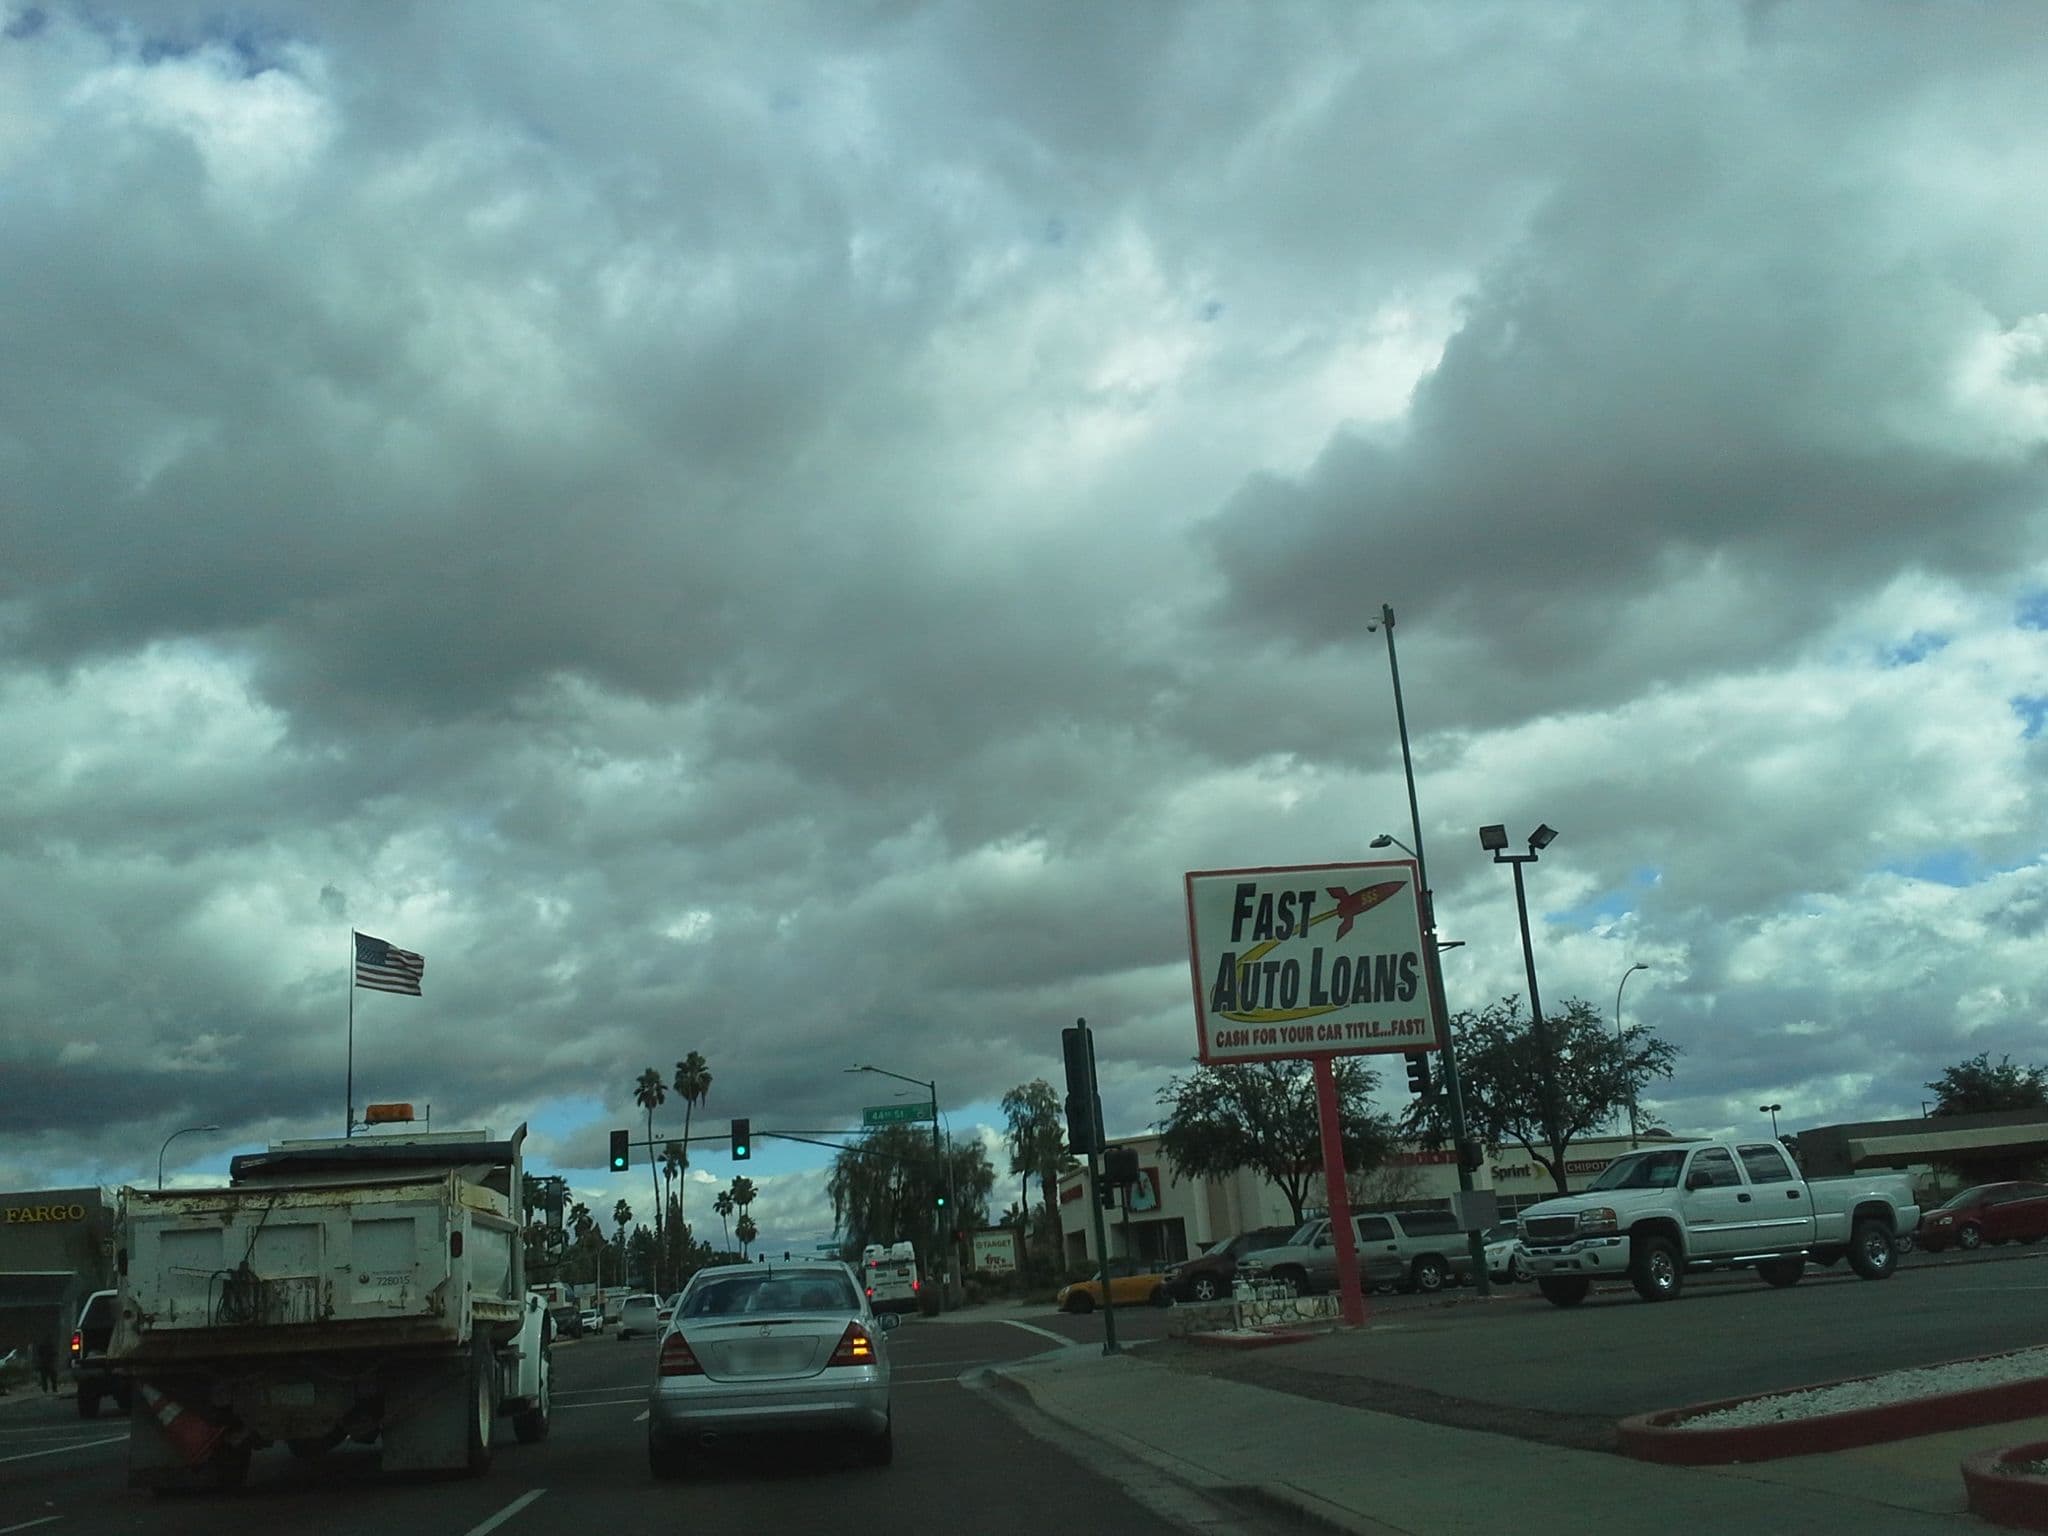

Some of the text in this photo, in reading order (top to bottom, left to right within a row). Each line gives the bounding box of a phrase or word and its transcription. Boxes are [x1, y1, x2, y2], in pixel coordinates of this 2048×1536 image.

[1231, 883, 1316, 943] FAST
[1211, 947, 1419, 1013] AUTO LOANS
[1216, 1029, 1249, 1048] CASH
[1253, 1027, 1277, 1045] FOR
[1280, 1025, 1313, 1043] YOUR
[1317, 1023, 1342, 1040] CAR
[1491, 1164, 1531, 1181] Sprint
[4, 1205, 85, 1223] FARGO
